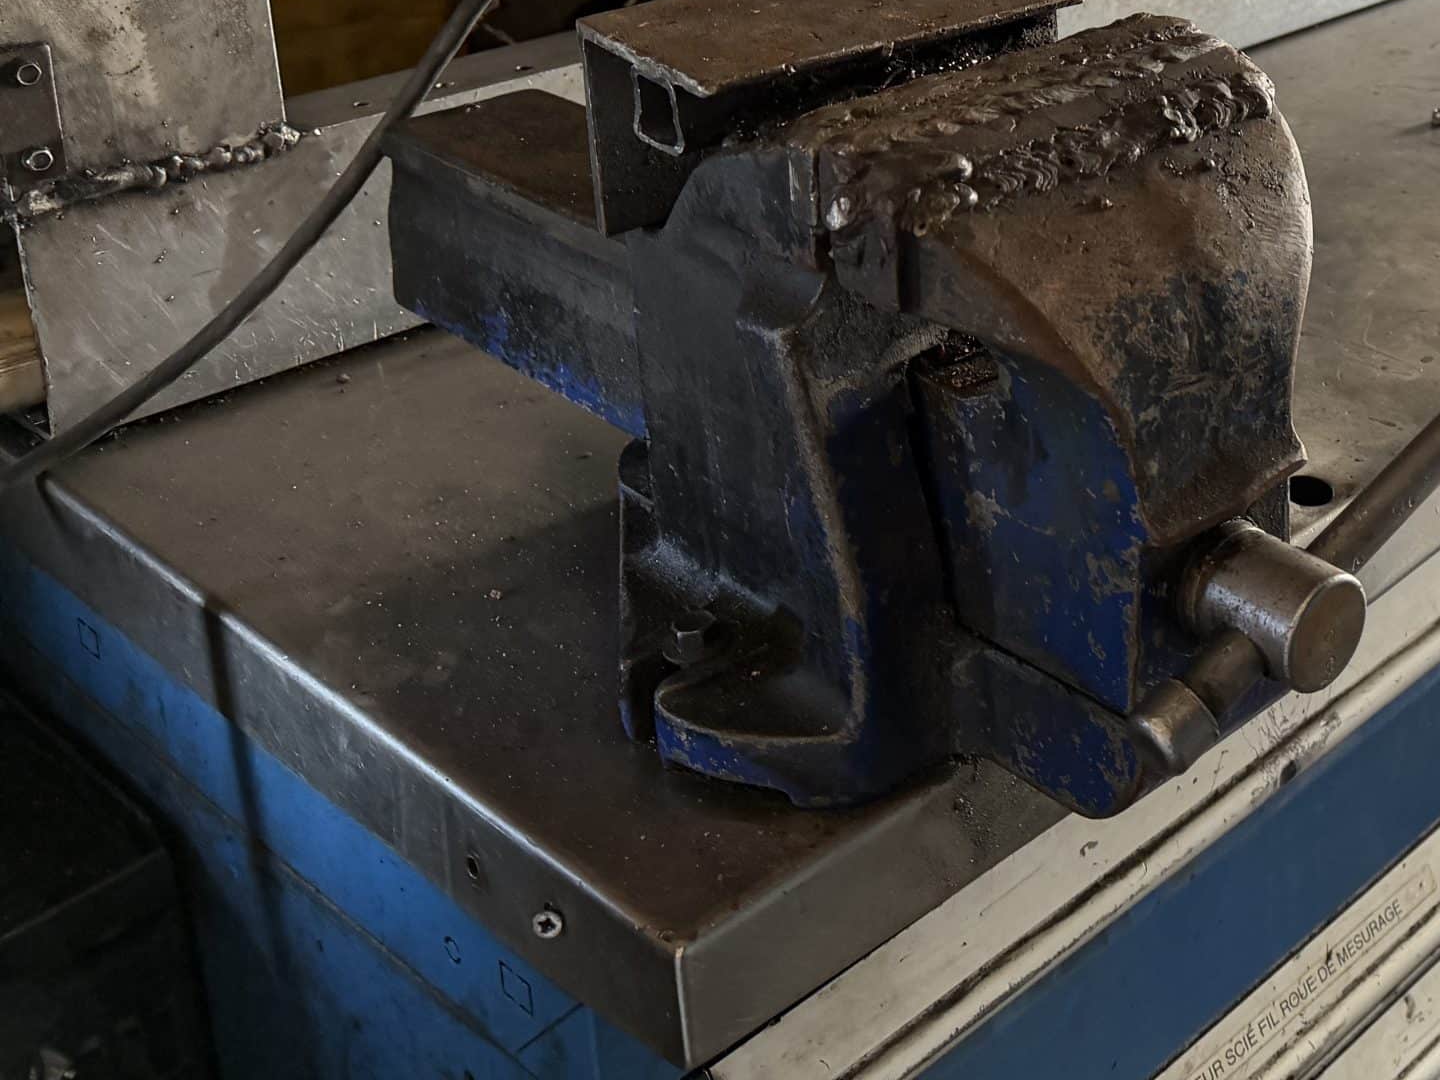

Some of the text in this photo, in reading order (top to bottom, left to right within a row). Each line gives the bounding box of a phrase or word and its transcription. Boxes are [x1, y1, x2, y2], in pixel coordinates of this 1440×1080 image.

[1257, 1012, 1281, 1038] FIL
[1279, 975, 1318, 1017] ROUE
[1316, 961, 1337, 983] DE
[1335, 899, 1404, 967] MESURAGE
